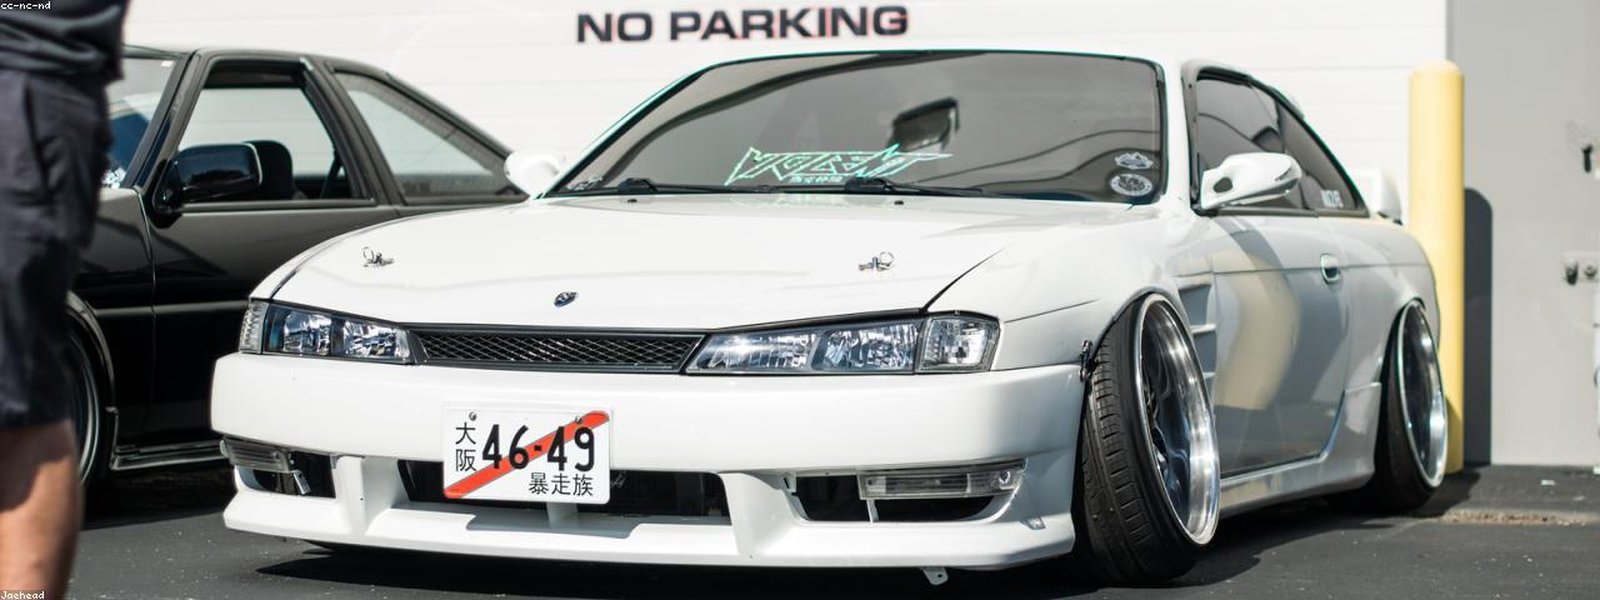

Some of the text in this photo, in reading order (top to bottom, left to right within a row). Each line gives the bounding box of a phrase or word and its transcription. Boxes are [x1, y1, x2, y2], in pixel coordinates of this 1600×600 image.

[576, 6, 909, 43] NO PARKING
[455, 421, 477, 472] 大阪
[528, 471, 594, 496] 暴走族
